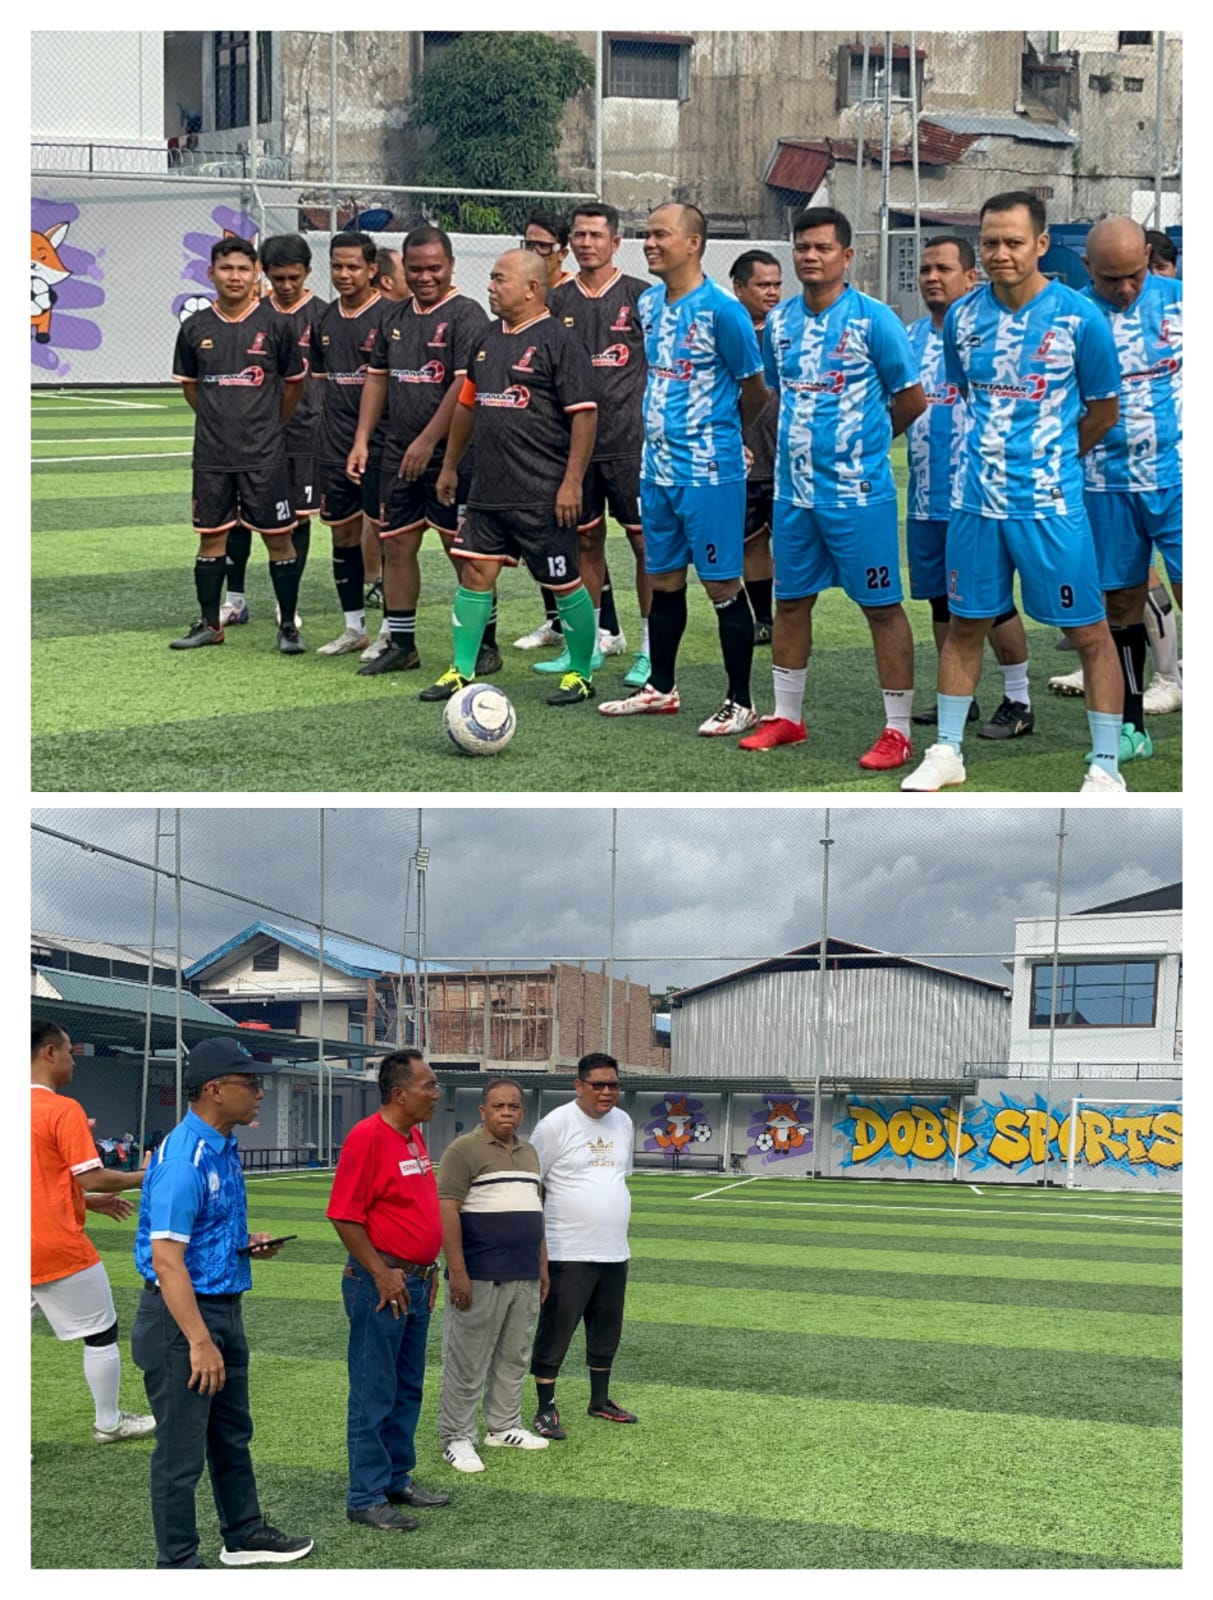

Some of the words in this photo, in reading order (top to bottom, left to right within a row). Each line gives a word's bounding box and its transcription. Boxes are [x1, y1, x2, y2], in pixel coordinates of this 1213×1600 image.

[304, 486, 313, 503] 7
[276, 500, 291, 521] 21
[706, 544, 717, 564] 2
[547, 555, 567, 577] 13
[865, 565, 891, 590] 22
[1059, 584, 1074, 609] 9
[987, 1106, 1182, 1170] SPORTS
